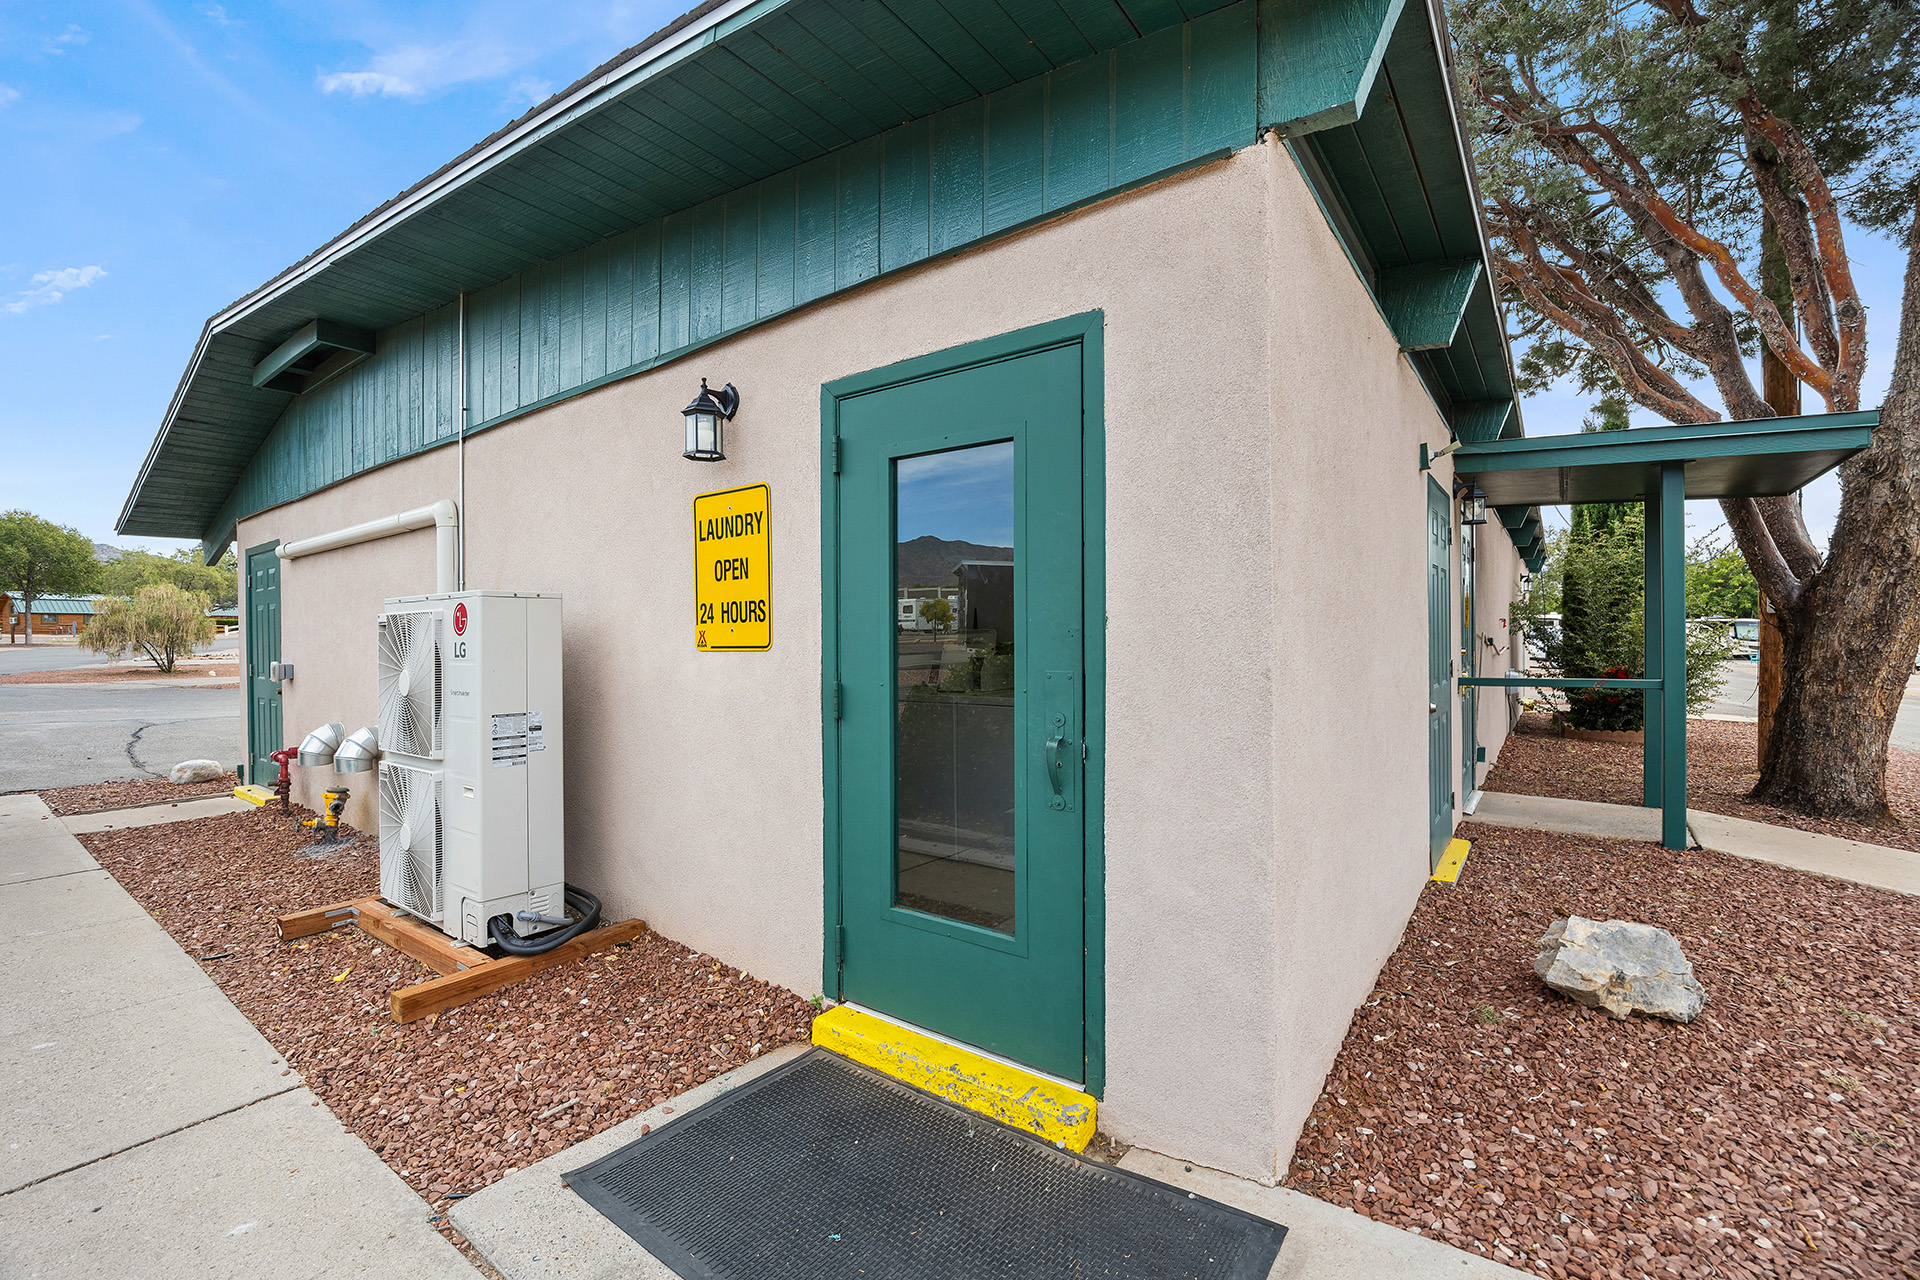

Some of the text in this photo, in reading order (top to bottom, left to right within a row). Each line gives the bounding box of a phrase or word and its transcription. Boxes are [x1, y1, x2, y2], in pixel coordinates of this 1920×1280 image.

[699, 511, 763, 541] LAUNDRY
[715, 558, 748, 582] OPEN
[700, 600, 766, 624] 24 HOURS
[455, 642, 466, 658] LG
